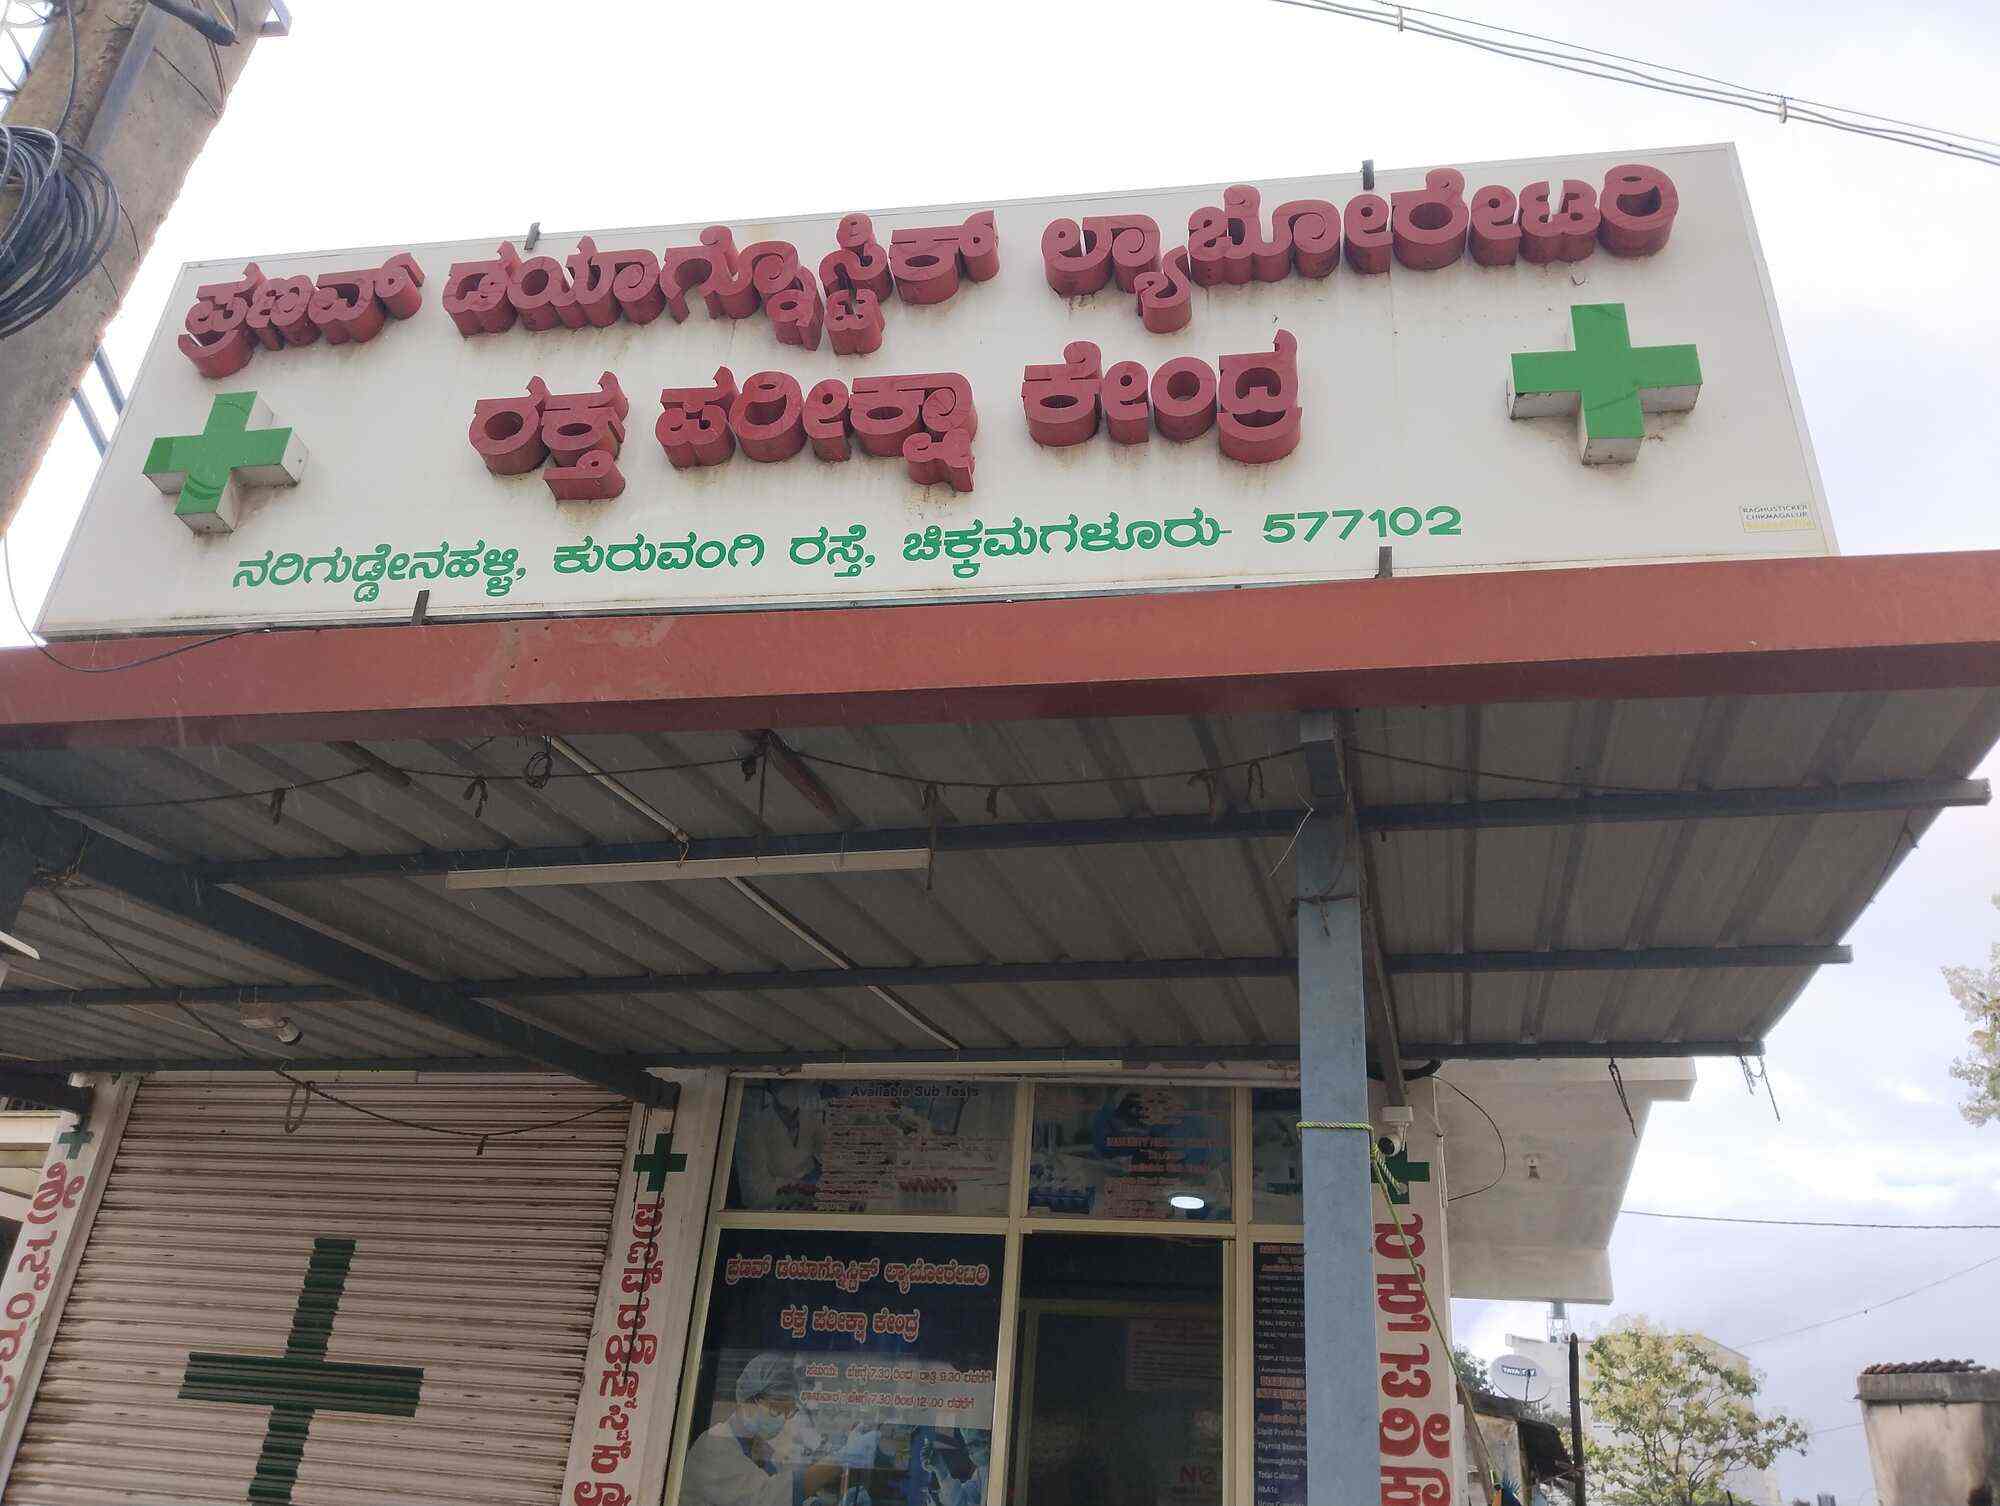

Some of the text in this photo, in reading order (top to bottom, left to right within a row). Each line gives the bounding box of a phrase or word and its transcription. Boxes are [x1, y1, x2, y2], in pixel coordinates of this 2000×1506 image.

[178, 254, 426, 381] ಪ್ರಣವ್
[469, 329, 1303, 504] ರಕ್ತ ಪರೀಕ್ಷಾ ಕೇಂದ್ರ
[554, 532, 767, 575] ಕುರುವಂಗಿ
[790, 524, 877, 579] ರಸ್ತೆ,
[1264, 506, 1463, 545] 577102
[850, 1085, 980, 1098] Available Sub Tests
